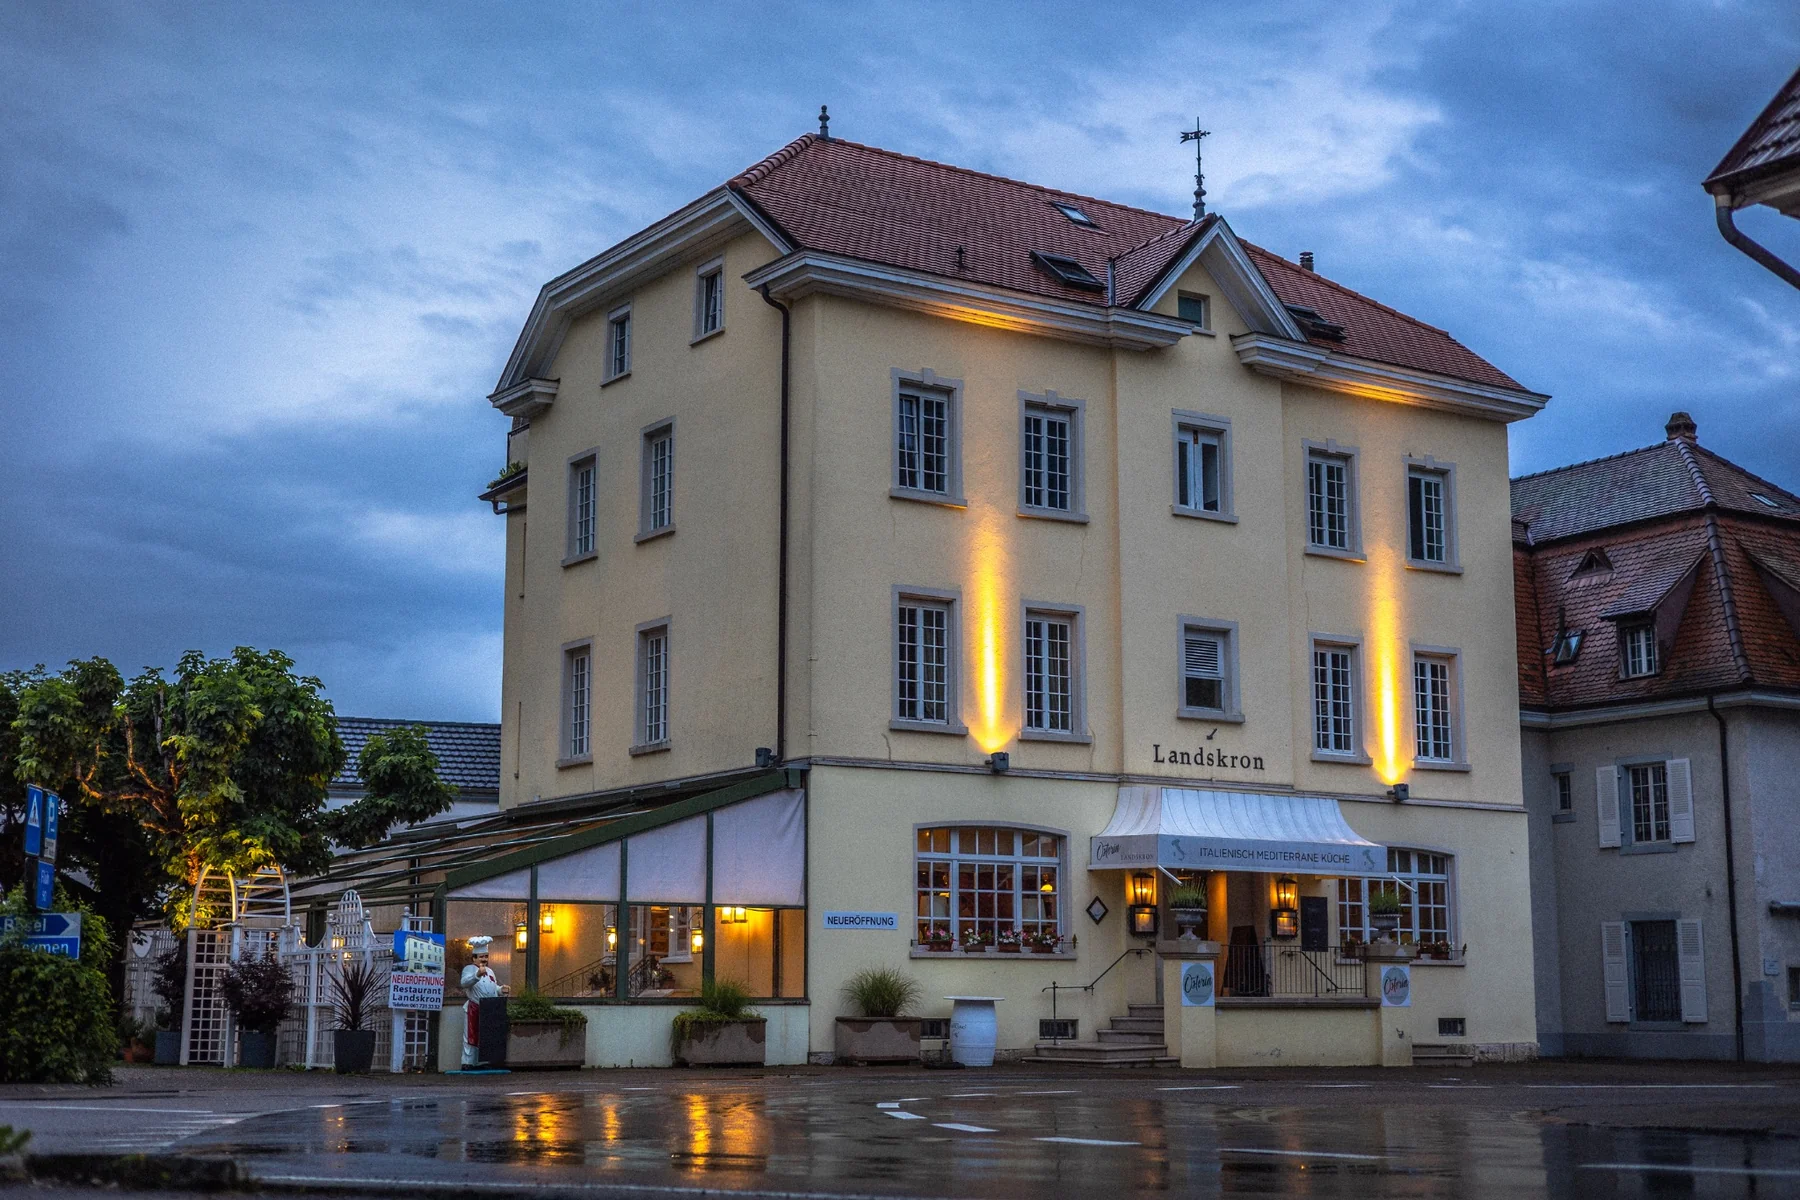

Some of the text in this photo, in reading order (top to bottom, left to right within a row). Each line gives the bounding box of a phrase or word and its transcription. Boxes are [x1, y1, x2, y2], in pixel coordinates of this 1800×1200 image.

[1153, 744, 1265, 770] Landskron
[1200, 847, 1350, 864] ITALIENISCH MEDITERRANE KÜCHE
[827, 914, 894, 926] NEUERÖFFNUNG
[393, 985, 441, 994] Restaurant
[392, 994, 441, 1003] Landskron
